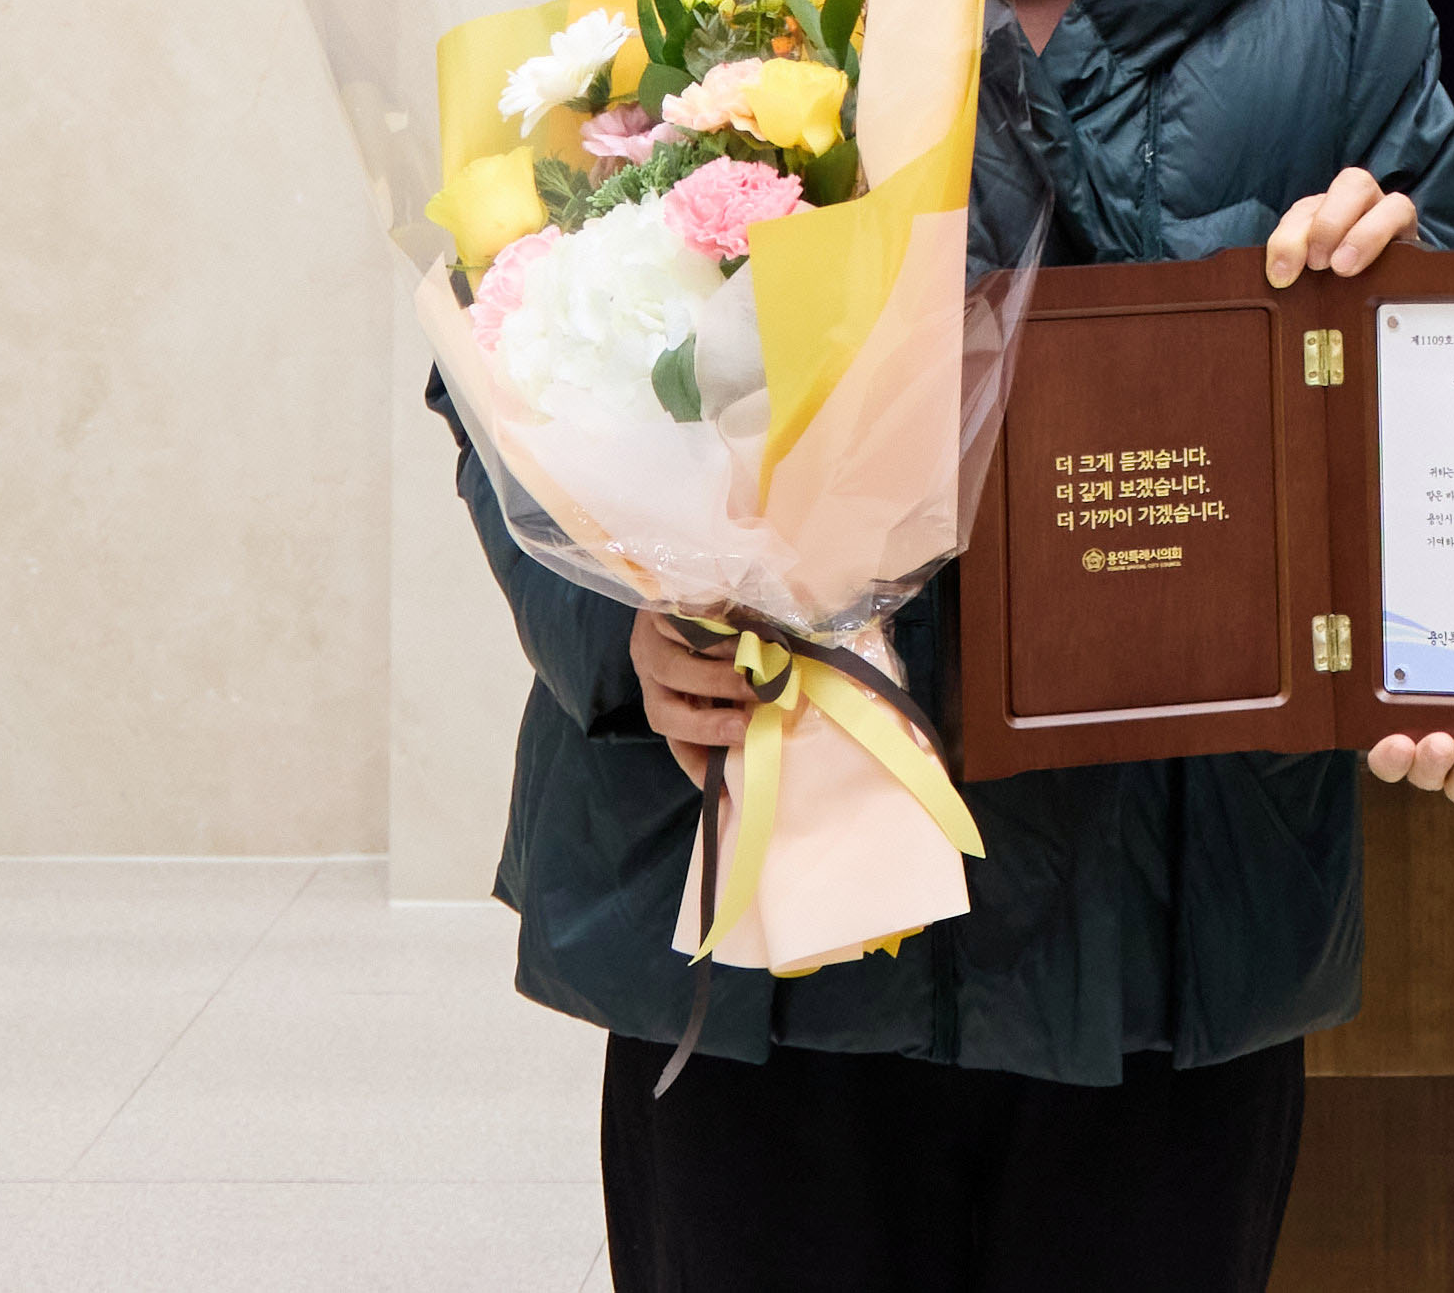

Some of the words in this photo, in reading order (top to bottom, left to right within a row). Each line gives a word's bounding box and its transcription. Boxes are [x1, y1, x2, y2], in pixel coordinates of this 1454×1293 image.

[1410, 334, 1454, 346] 제1109호
[1055, 455, 1073, 476] 더
[1078, 452, 1115, 473] 크게
[1119, 446, 1212, 471] 듣겠습니다.
[1056, 483, 1074, 503] 더
[1078, 480, 1114, 503] 깊게
[1118, 474, 1211, 499] 보겠습니다.
[1057, 511, 1075, 532] 더
[1079, 506, 1134, 530] 가까이
[1137, 500, 1230, 526] 가겠습니다.
[1426, 512, 1453, 526] 용인시
[1106, 547, 1183, 566] 용인특례시의회
